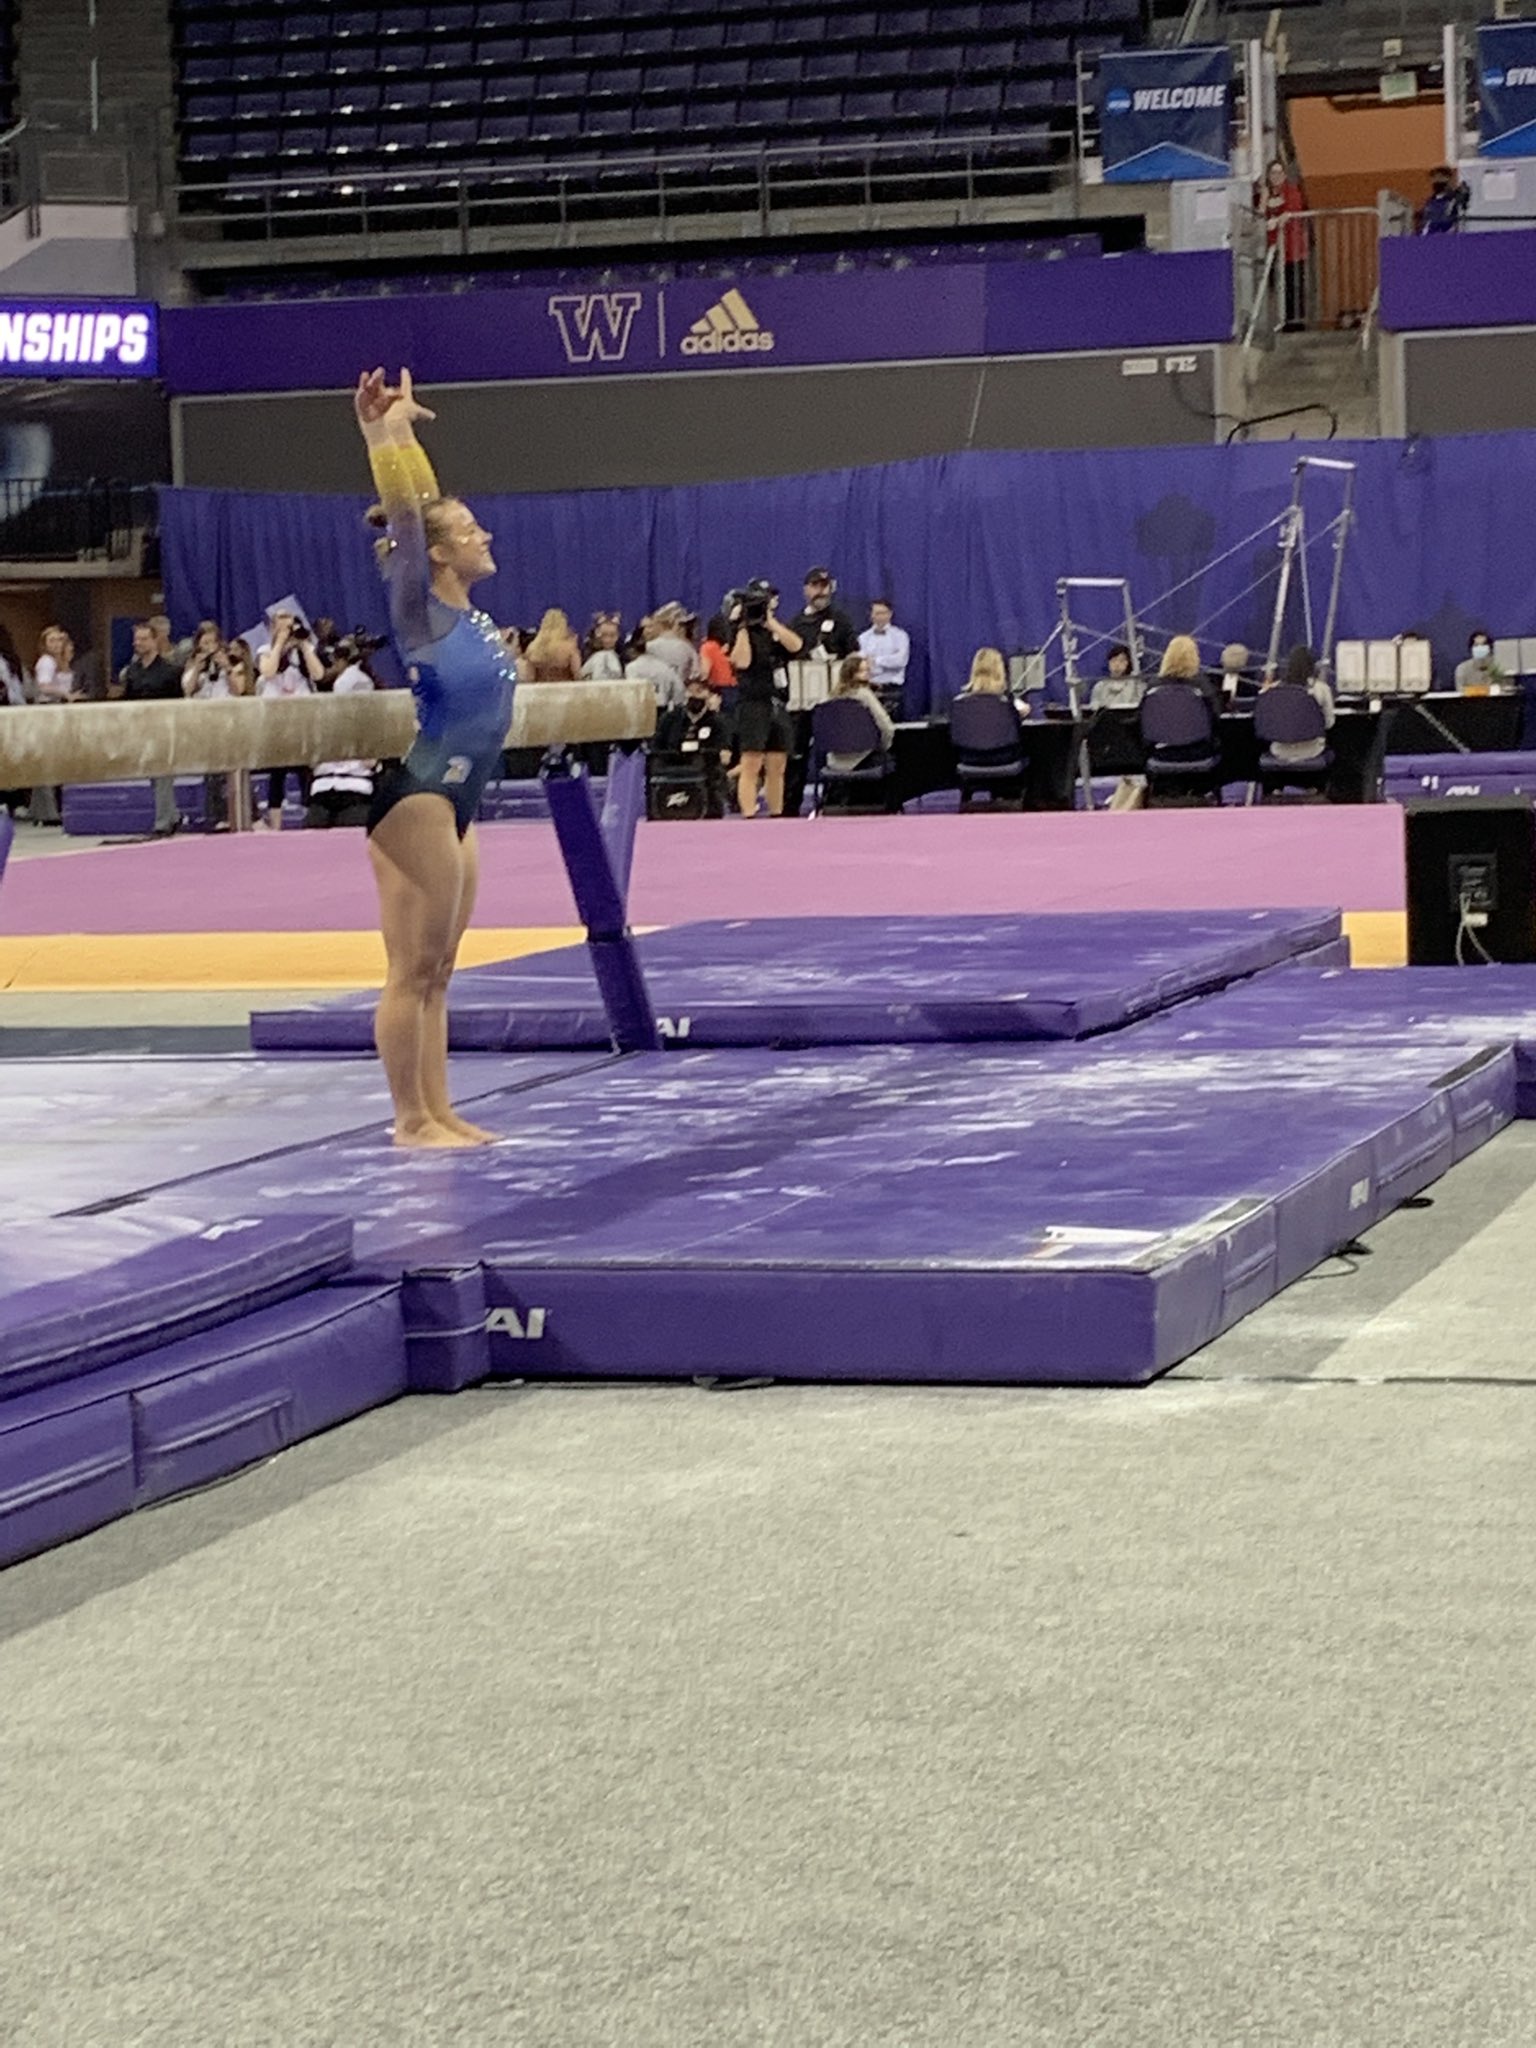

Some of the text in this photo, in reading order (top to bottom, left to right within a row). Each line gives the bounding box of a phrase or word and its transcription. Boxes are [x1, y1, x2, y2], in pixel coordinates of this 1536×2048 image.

[1133, 84, 1227, 112] WELCOME
[0, 312, 150, 364] NSHIPS
[548, 292, 642, 363] W
[680, 328, 775, 355] adidas
